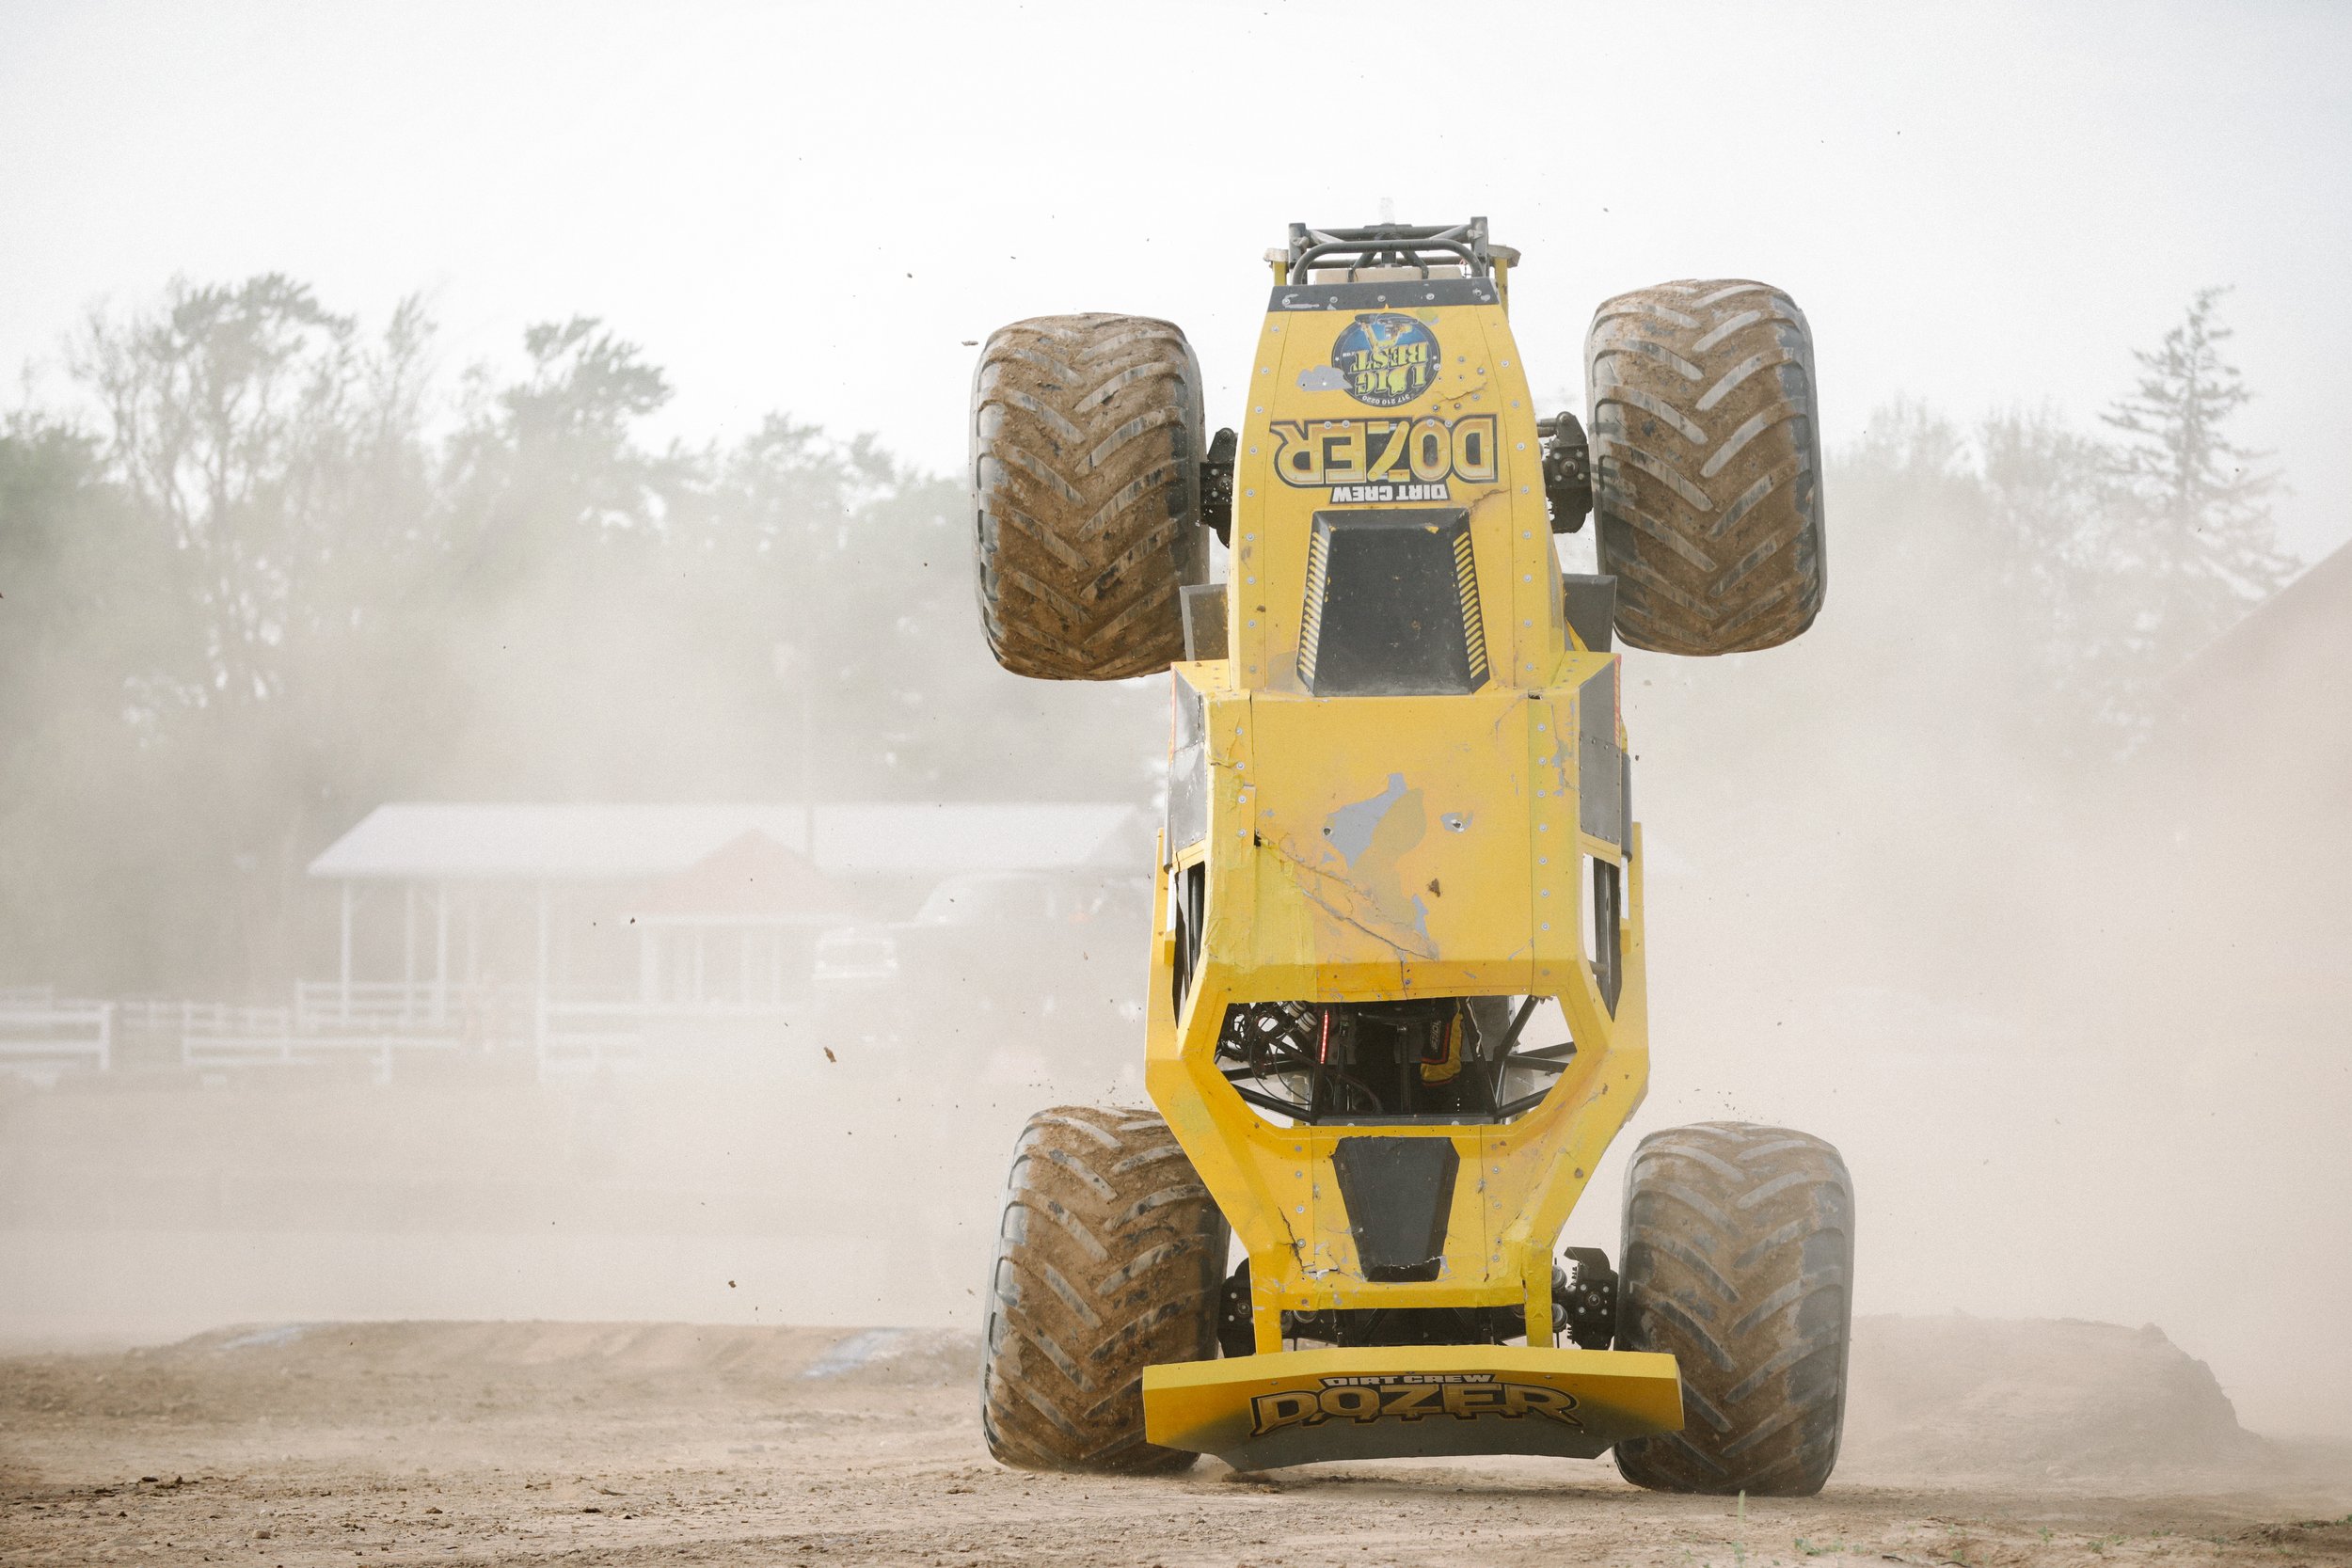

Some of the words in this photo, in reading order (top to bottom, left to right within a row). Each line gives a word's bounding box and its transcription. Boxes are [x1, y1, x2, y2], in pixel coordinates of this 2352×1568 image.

[1352, 341, 1428, 372] BEST
[1356, 363, 1411, 395] DIG
[1413, 362, 1427, 388] I
[1362, 395, 1381, 404] 0220
[1397, 394, 1410, 404] 317
[1270, 415, 1498, 487] DOZER
[1331, 484, 1393, 502] CREW
[1396, 483, 1448, 500] DIRT
[1324, 1376, 1398, 1386] DIRT
[1403, 1374, 1492, 1385] CREW
[1249, 1383, 1584, 1437] DOZER
